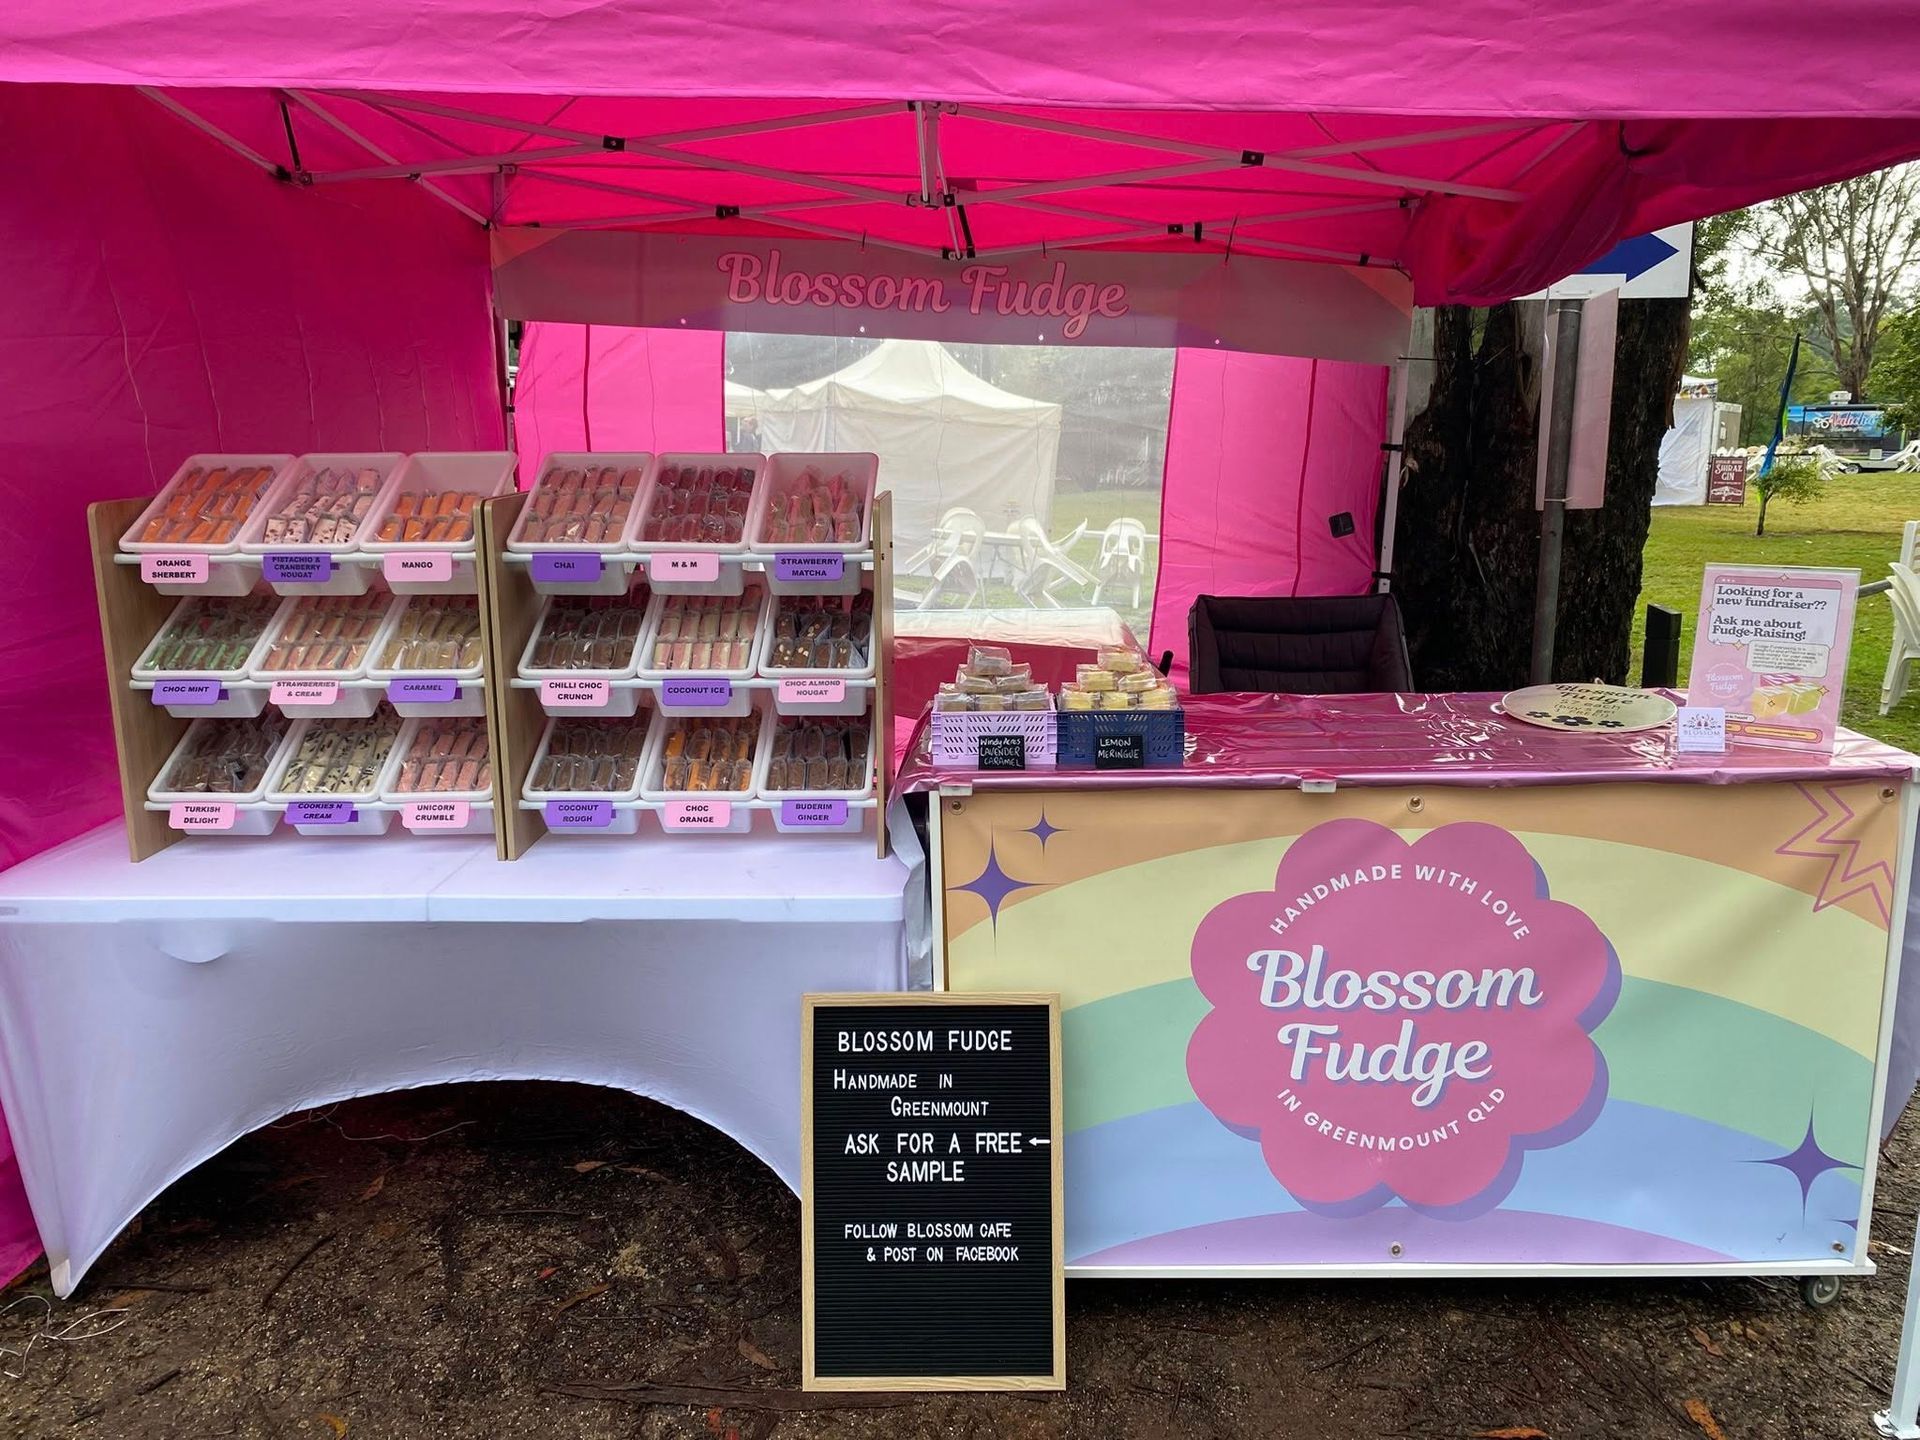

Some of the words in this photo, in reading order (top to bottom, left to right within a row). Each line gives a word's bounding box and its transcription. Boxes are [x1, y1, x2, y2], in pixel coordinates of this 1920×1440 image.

[717, 250, 950, 314] Blossom
[960, 262, 1130, 338] Fudge
[1715, 464, 1742, 474] SHIRAZ
[1721, 472, 1735, 480] GIN
[156, 560, 192, 568] ORANGE
[402, 561, 434, 569] MANGO
[554, 561, 575, 569] CHAI
[671, 561, 679, 569] M
[681, 561, 688, 569] &
[690, 561, 698, 569] M
[780, 558, 838, 566] STRAWBERRY
[152, 570, 196, 579] SHERBERT
[280, 571, 313, 579] NOUGAT
[792, 569, 827, 577] MATCHA
[1718, 586, 1770, 599] Looking
[1773, 588, 1793, 598] for
[1795, 591, 1803, 599] a
[1716, 596, 1742, 605] new
[1745, 597, 1827, 610] fundraiser??
[1714, 615, 1738, 625] Ask
[1741, 618, 1761, 626] me
[1763, 619, 1802, 629] about
[1712, 625, 1806, 641] Fudge-Raising!
[276, 681, 336, 689] STRAWBERRIES
[403, 684, 443, 692] CARAMEL
[549, 682, 578, 690] CHILLI
[579, 682, 602, 690] CHOC
[785, 680, 807, 688] CHOC
[809, 680, 840, 688] ALMOND
[162, 686, 186, 694] CHOC
[187, 686, 210, 694] MINT
[296, 690, 322, 698] CREAM
[667, 687, 708, 695] COCONUT
[796, 689, 828, 697] NOUGAT
[1555, 685, 1652, 700] Blossom
[557, 693, 593, 701] CRUNCH
[1560, 692, 1634, 704] Fudge
[980, 738, 999, 748] Windy
[1100, 737, 1131, 747] LEMON
[980, 747, 1020, 757] LAVENDER
[1098, 749, 1139, 759] MERINGUE
[984, 756, 1023, 767] CARAMEL
[184, 805, 221, 814] TURKISH
[298, 802, 333, 810] COOKIES
[335, 802, 343, 810] N
[417, 804, 455, 812] UNICORN
[558, 804, 598, 812] COCONUT
[685, 804, 709, 813] CHOC
[795, 803, 833, 811] BUDERIM
[183, 816, 219, 824] DELIGHT
[303, 812, 332, 820] CREAM
[415, 814, 455, 822] CRUMBLE
[562, 815, 593, 823] ROUGH
[680, 815, 714, 824] ORANGE
[797, 813, 829, 822] GINGER
[1270, 864, 1402, 934] HANDMADE
[1415, 864, 1478, 895] WITH
[1480, 889, 1530, 940] LOVE
[1246, 944, 1544, 1010] Blossom
[838, 1030, 933, 1052] BLOSSOM
[948, 1030, 1012, 1051] FUDGE
[1277, 1019, 1493, 1108] Fudge
[939, 1074, 952, 1089] IN
[1277, 1088, 1302, 1112] IN
[1303, 1112, 1461, 1152] GREENMOUNT
[1467, 1087, 1506, 1124] QLD
[844, 1133, 880, 1154] ASK
[897, 1133, 934, 1154] FOR
[949, 1133, 961, 1154] A
[976, 1132, 1022, 1153] FREE
[887, 1161, 965, 1182] SAMPLE
[845, 1223, 898, 1240] FOLLOW
[907, 1223, 973, 1238] BLOSSOM
[979, 1222, 1012, 1238] CAFE
[866, 1246, 876, 1262] &
[884, 1246, 917, 1262] POST
[926, 1246, 944, 1262] ON
[955, 1246, 1019, 1261] FACEBOOK
